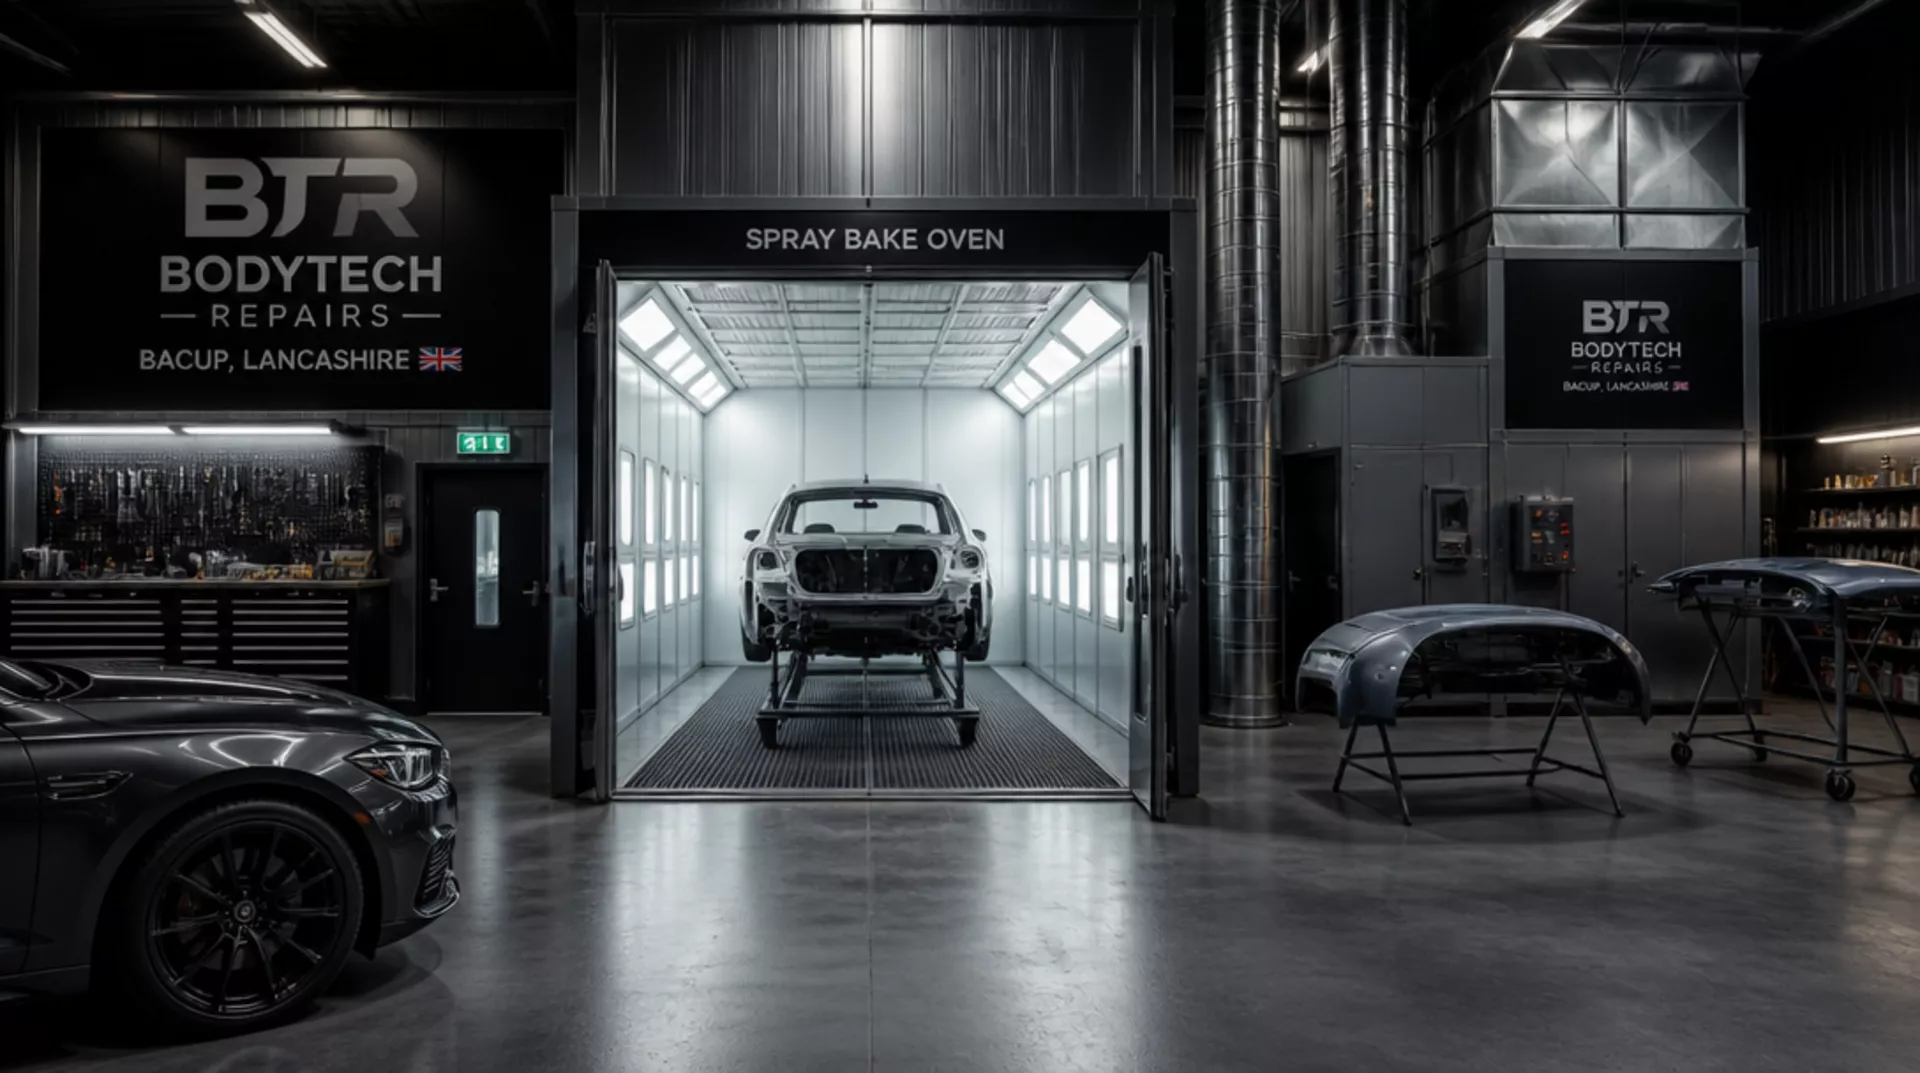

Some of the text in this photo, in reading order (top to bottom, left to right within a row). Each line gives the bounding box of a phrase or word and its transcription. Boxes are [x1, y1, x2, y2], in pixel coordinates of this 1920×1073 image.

[185, 156, 419, 238] BTR
[746, 227, 1005, 250] SPRAY BAKE OVEN
[160, 254, 442, 293] BODYTECH
[211, 303, 389, 328] REPAIRS
[1582, 299, 1670, 334] BTR
[139, 348, 410, 374] BACUP, LANCASHIRE
[1571, 341, 1682, 358] BODYTECH
[1590, 361, 1664, 374] REPAIRS
